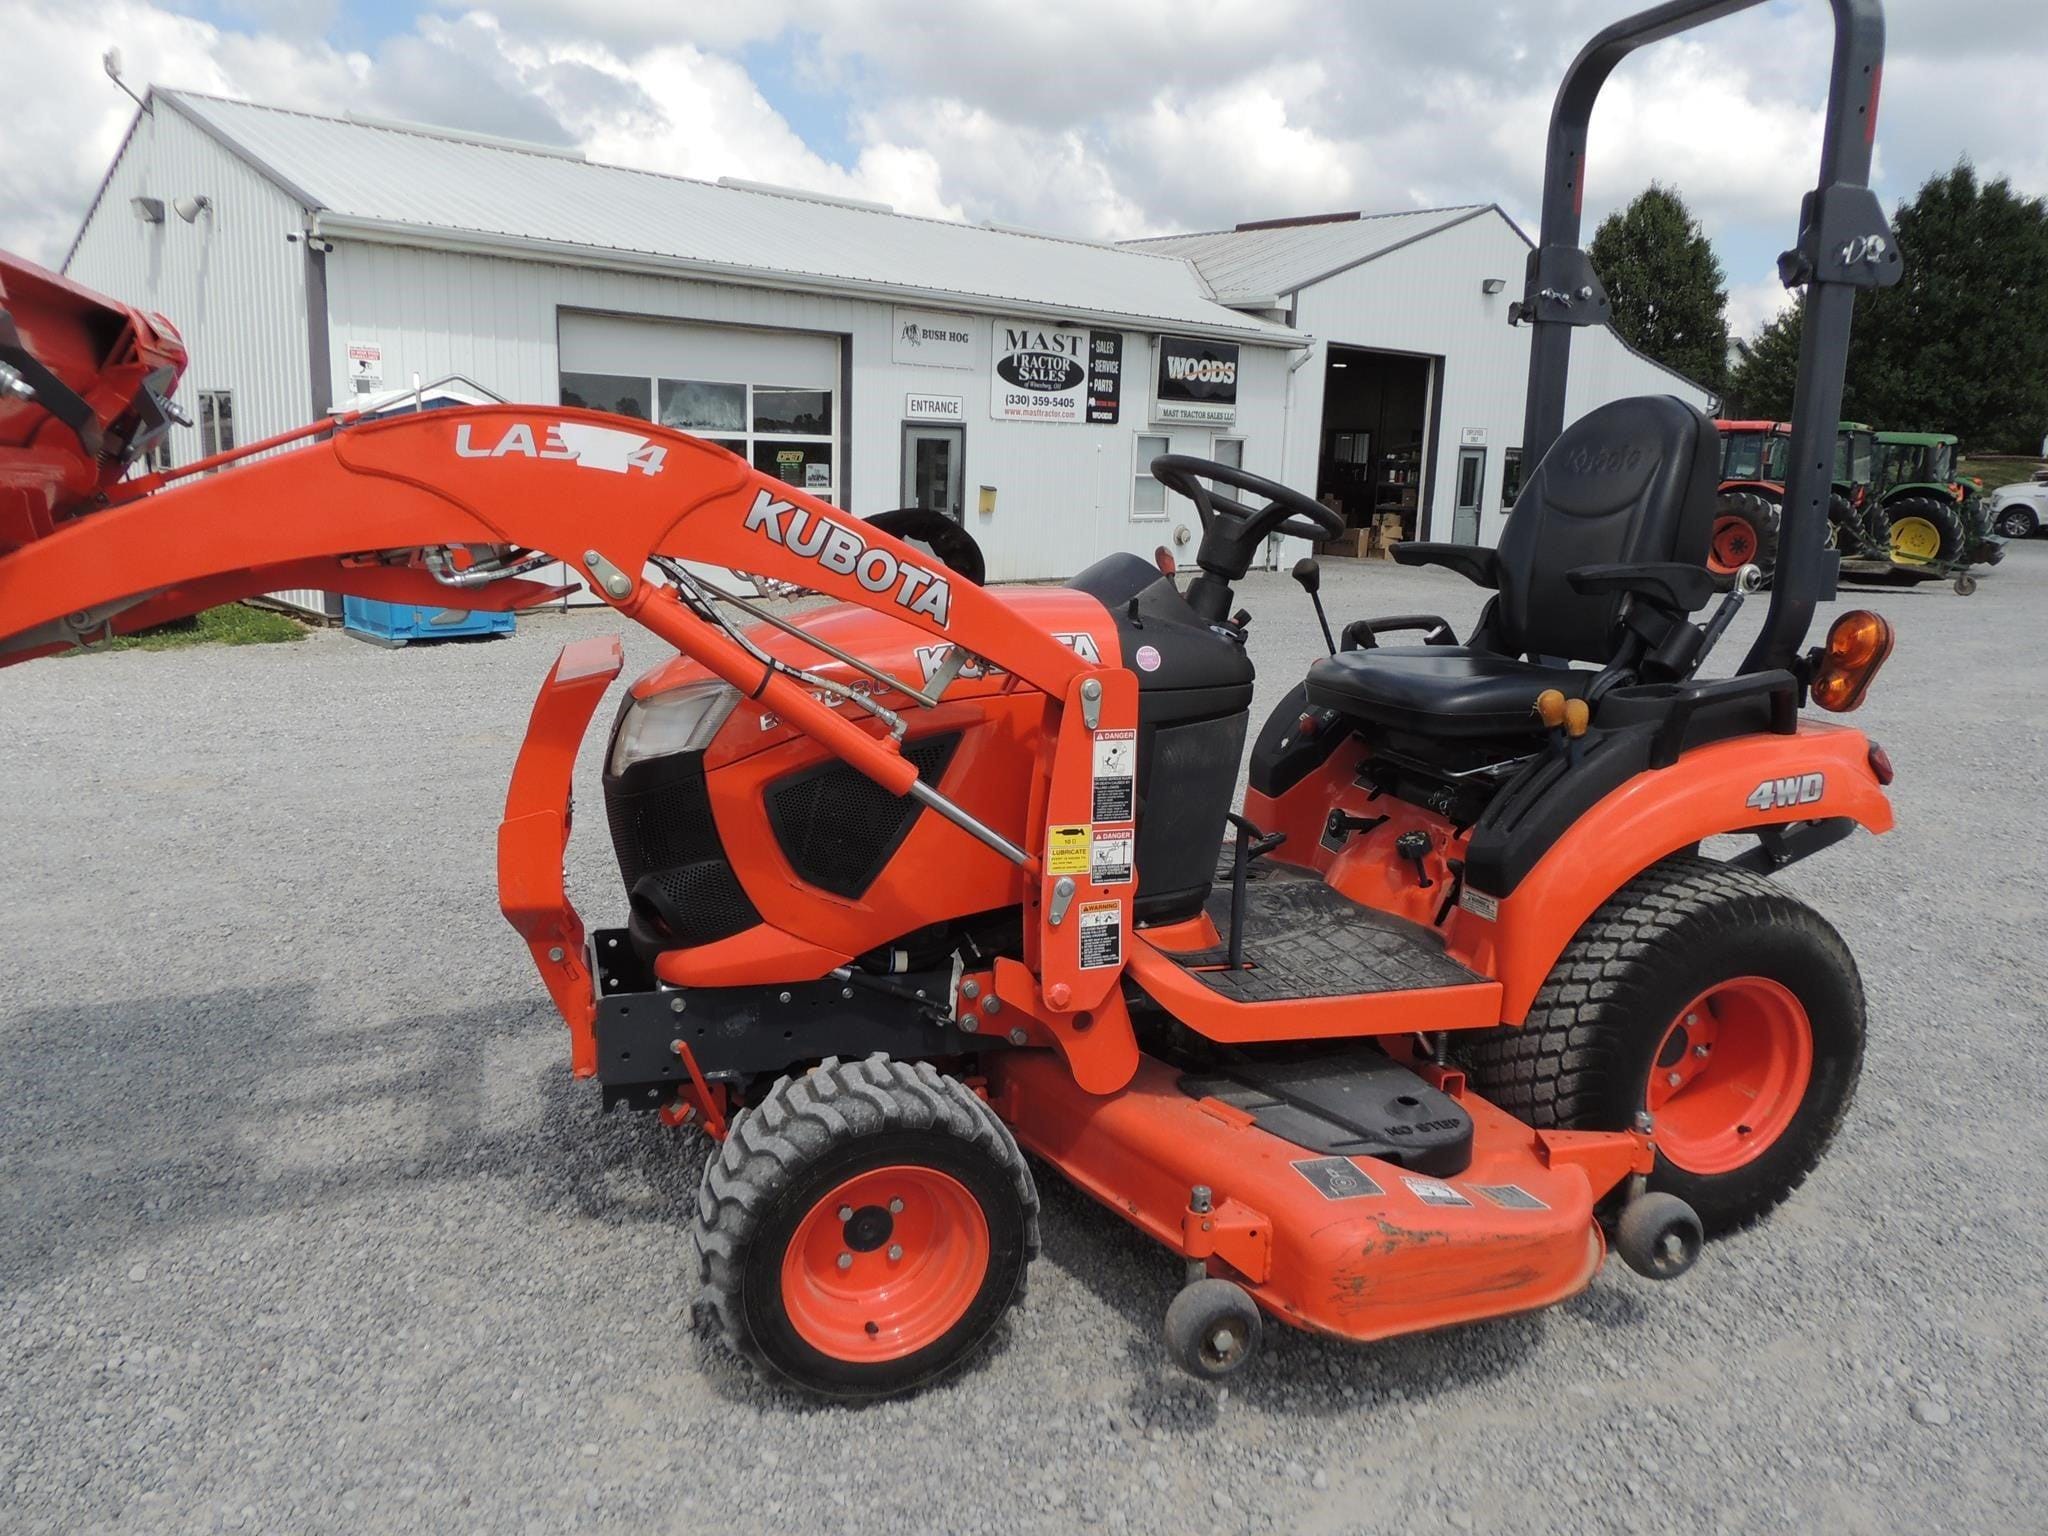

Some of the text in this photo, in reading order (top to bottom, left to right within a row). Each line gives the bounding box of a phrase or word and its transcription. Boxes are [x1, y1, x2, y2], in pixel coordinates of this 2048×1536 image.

[922, 329, 969, 343] BUSH HOG
[1005, 328, 1083, 357] MAST
[1095, 340, 1114, 354] SALES
[1013, 351, 1070, 371] TRACTOR
[1094, 360, 1119, 374] SERVICE
[1018, 367, 1066, 382] SALES
[1167, 356, 1235, 384] WOODS
[1093, 379, 1113, 393] PARTS
[911, 400, 959, 413] ENTRANCE
[1005, 394, 1075, 408] (330) 359-5405
[1005, 408, 1075, 418] www.masttractor.com
[1163, 409, 1179, 417] MAST
[1180, 410, 1206, 419] TRACTOR
[1207, 412, 1223, 420] SALES
[744, 488, 949, 628] KUBOTA
[1104, 732, 1133, 740] DANGER
[1746, 772, 1824, 811] 4WD
[1102, 832, 1131, 840] DANGER
[1088, 903, 1117, 911] WARNING
[1384, 1118, 1460, 1136] NO STEP
